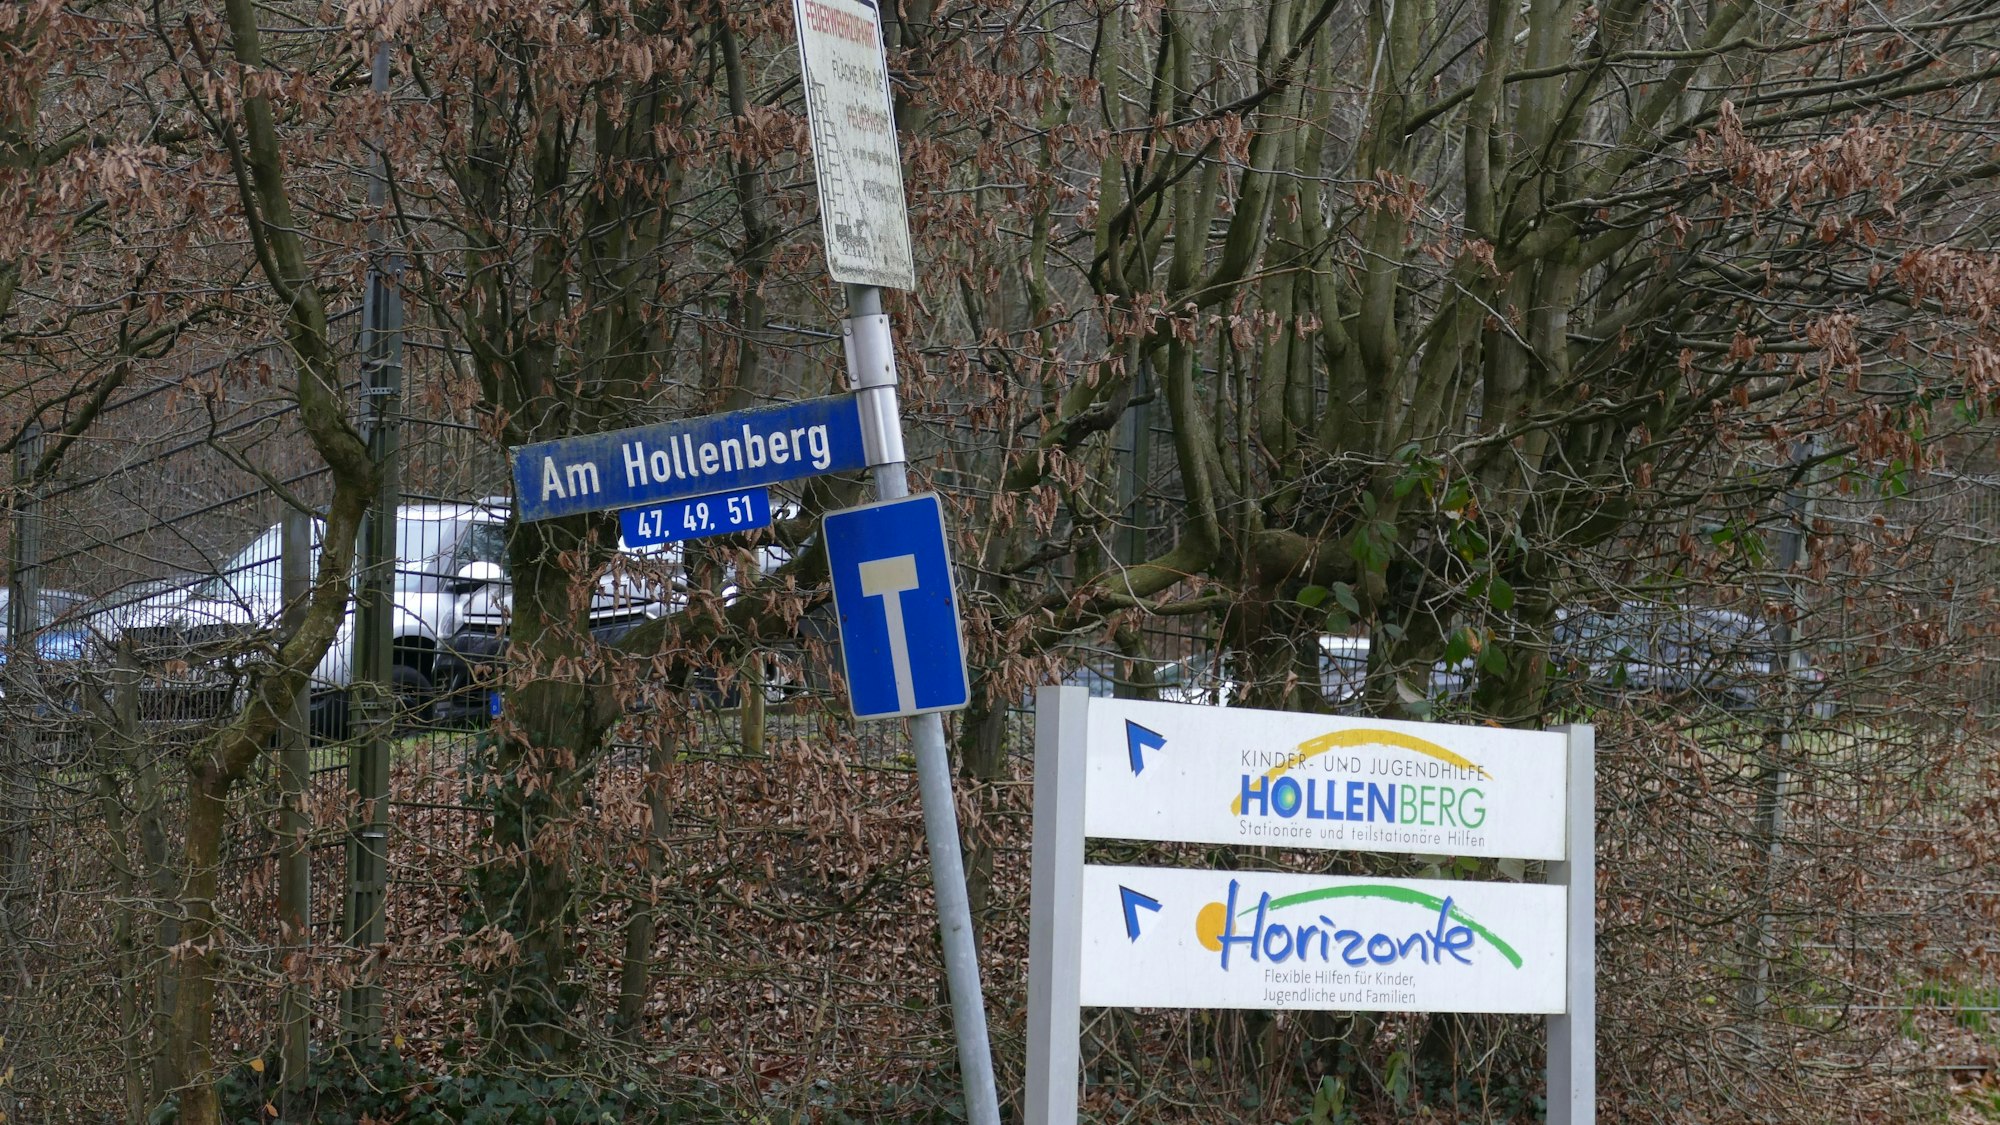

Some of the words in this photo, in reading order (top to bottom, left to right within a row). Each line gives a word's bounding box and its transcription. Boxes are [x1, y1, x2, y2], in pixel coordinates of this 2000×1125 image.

[541, 455, 601, 502] Am
[621, 424, 831, 488] Hollenberg
[637, 508, 670, 539] 47,
[683, 501, 716, 532] 49,
[728, 495, 754, 525] 51
[1241, 749, 1314, 771] KINDER-
[1323, 755, 1362, 774] UND
[1369, 758, 1485, 782] JUGENDHILFE
[1240, 774, 1487, 829] HOLLENBERG
[1239, 819, 1313, 839] Stationäre
[1319, 825, 1345, 840] und
[1351, 825, 1442, 846] teilstationäre
[1447, 830, 1486, 848] Hilfen
[1217, 878, 1475, 972] Horizonte
[1263, 989, 1336, 1006] Jugendliche
[1339, 990, 1363, 1004] und
[1366, 990, 1416, 1004] Familien
[1264, 969, 1312, 985] Flexible
[1315, 969, 1351, 985] Hilfen
[1354, 970, 1373, 986] für
[1375, 971, 1416, 988] Kinder,
